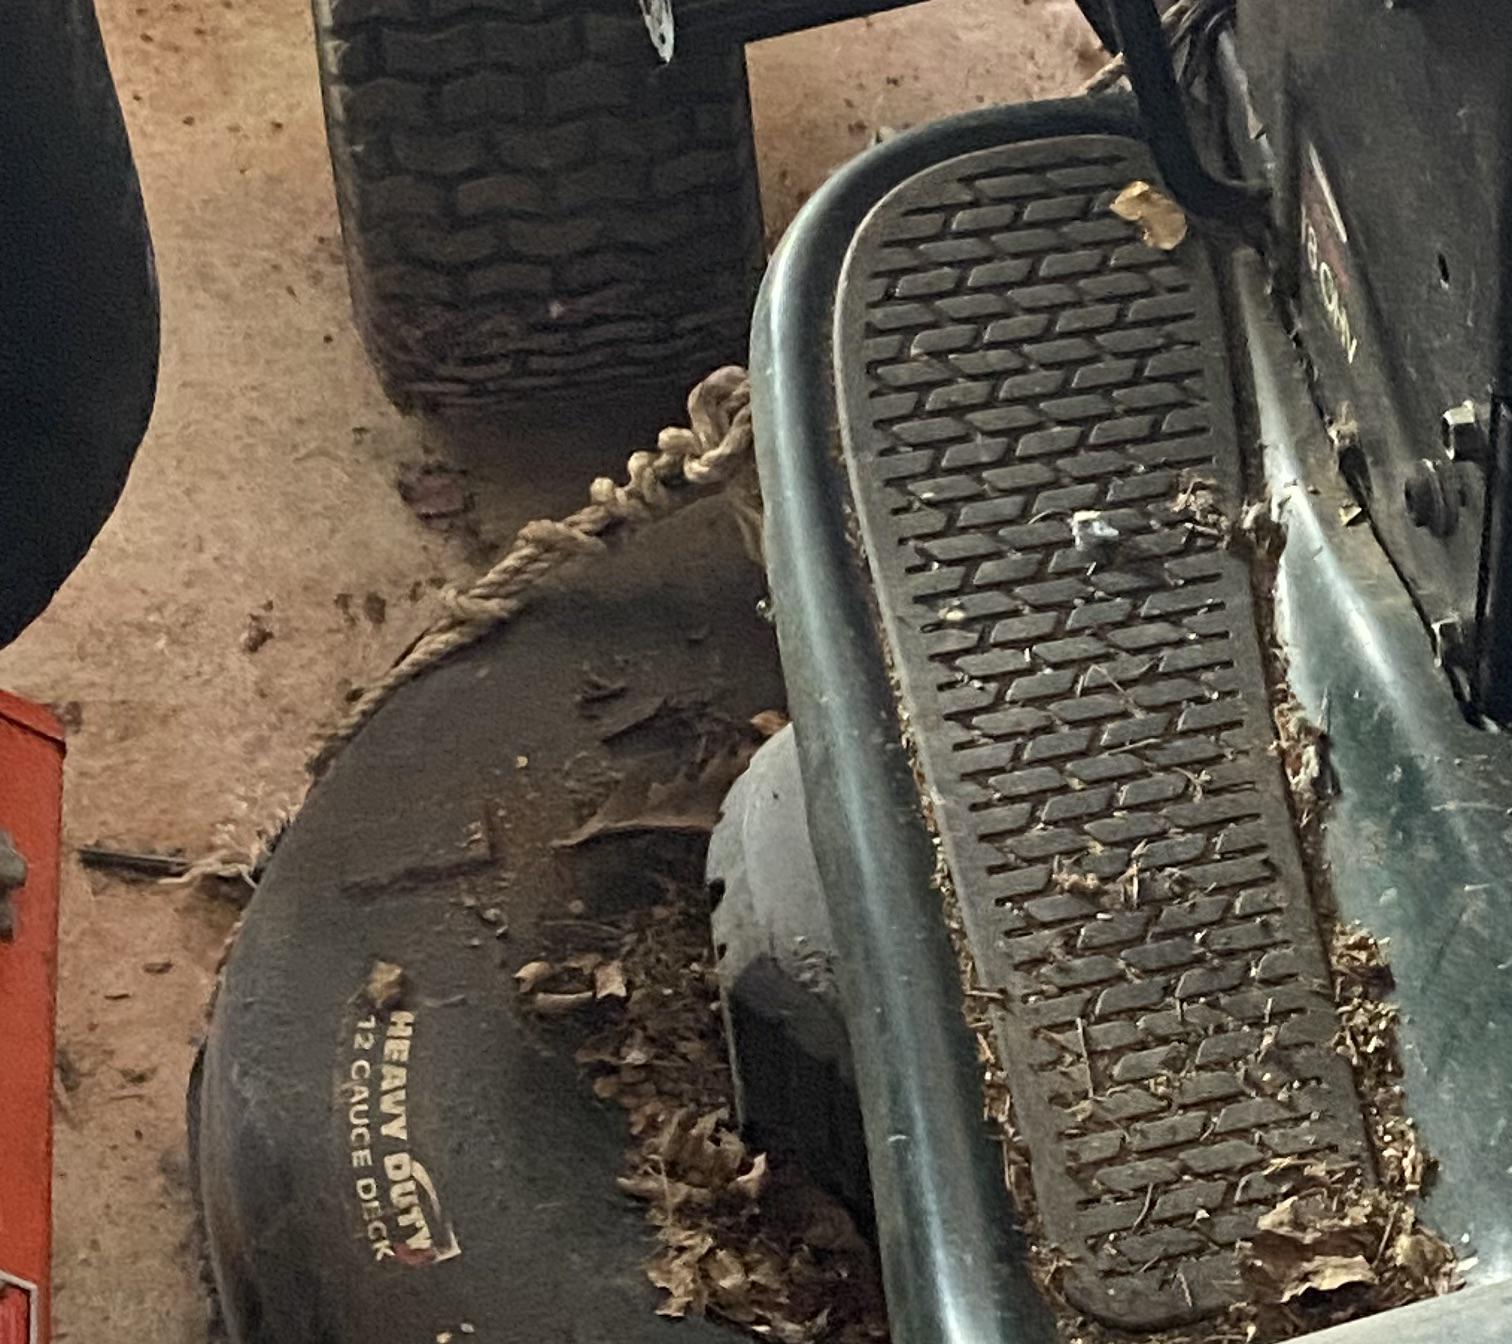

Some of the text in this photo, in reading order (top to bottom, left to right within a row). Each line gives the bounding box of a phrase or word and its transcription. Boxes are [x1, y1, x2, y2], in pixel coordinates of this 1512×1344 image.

[353, 1014, 377, 1051] 12
[380, 1010, 433, 1251] HEAVY DUTY
[356, 1177, 396, 1262] DECK
